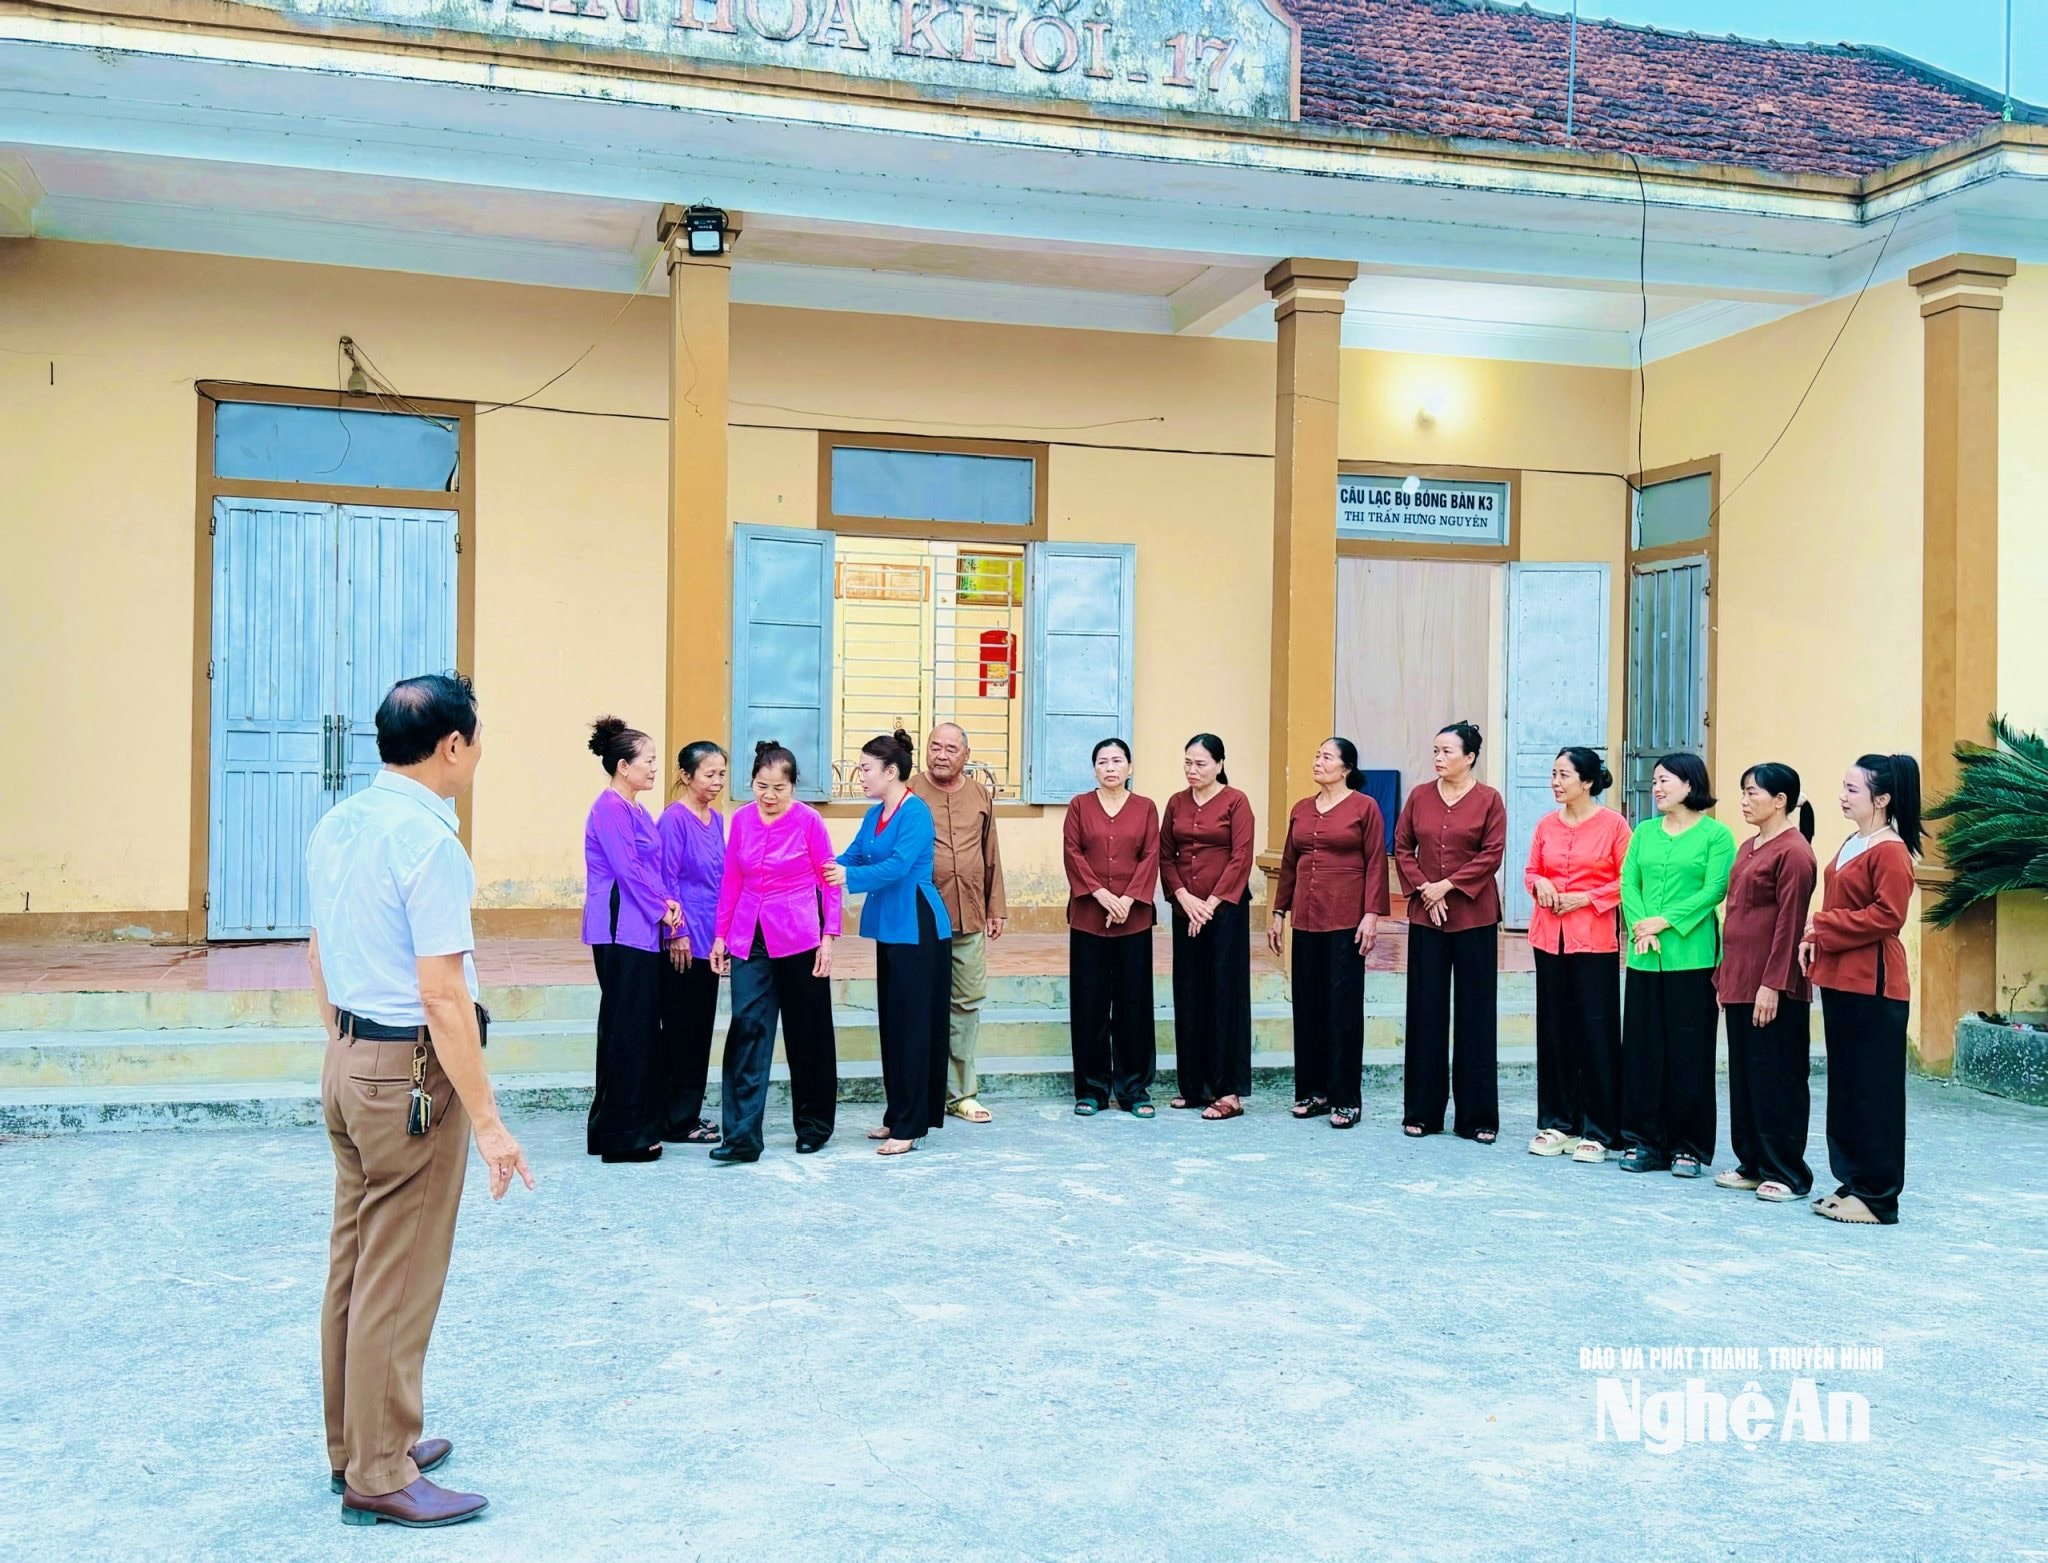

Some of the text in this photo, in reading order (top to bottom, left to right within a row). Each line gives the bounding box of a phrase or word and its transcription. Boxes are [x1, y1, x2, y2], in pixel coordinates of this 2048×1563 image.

[1163, 32, 1237, 92] 17
[1340, 486, 1365, 504] CÂU
[1369, 489, 1391, 508] LẠC
[1414, 489, 1447, 509] BÓNG
[1451, 491, 1475, 510] BÀN
[1478, 495, 1493, 511] K3
[1344, 508, 1488, 527] THỊ TRẤN HƯNG NGUYÊN
